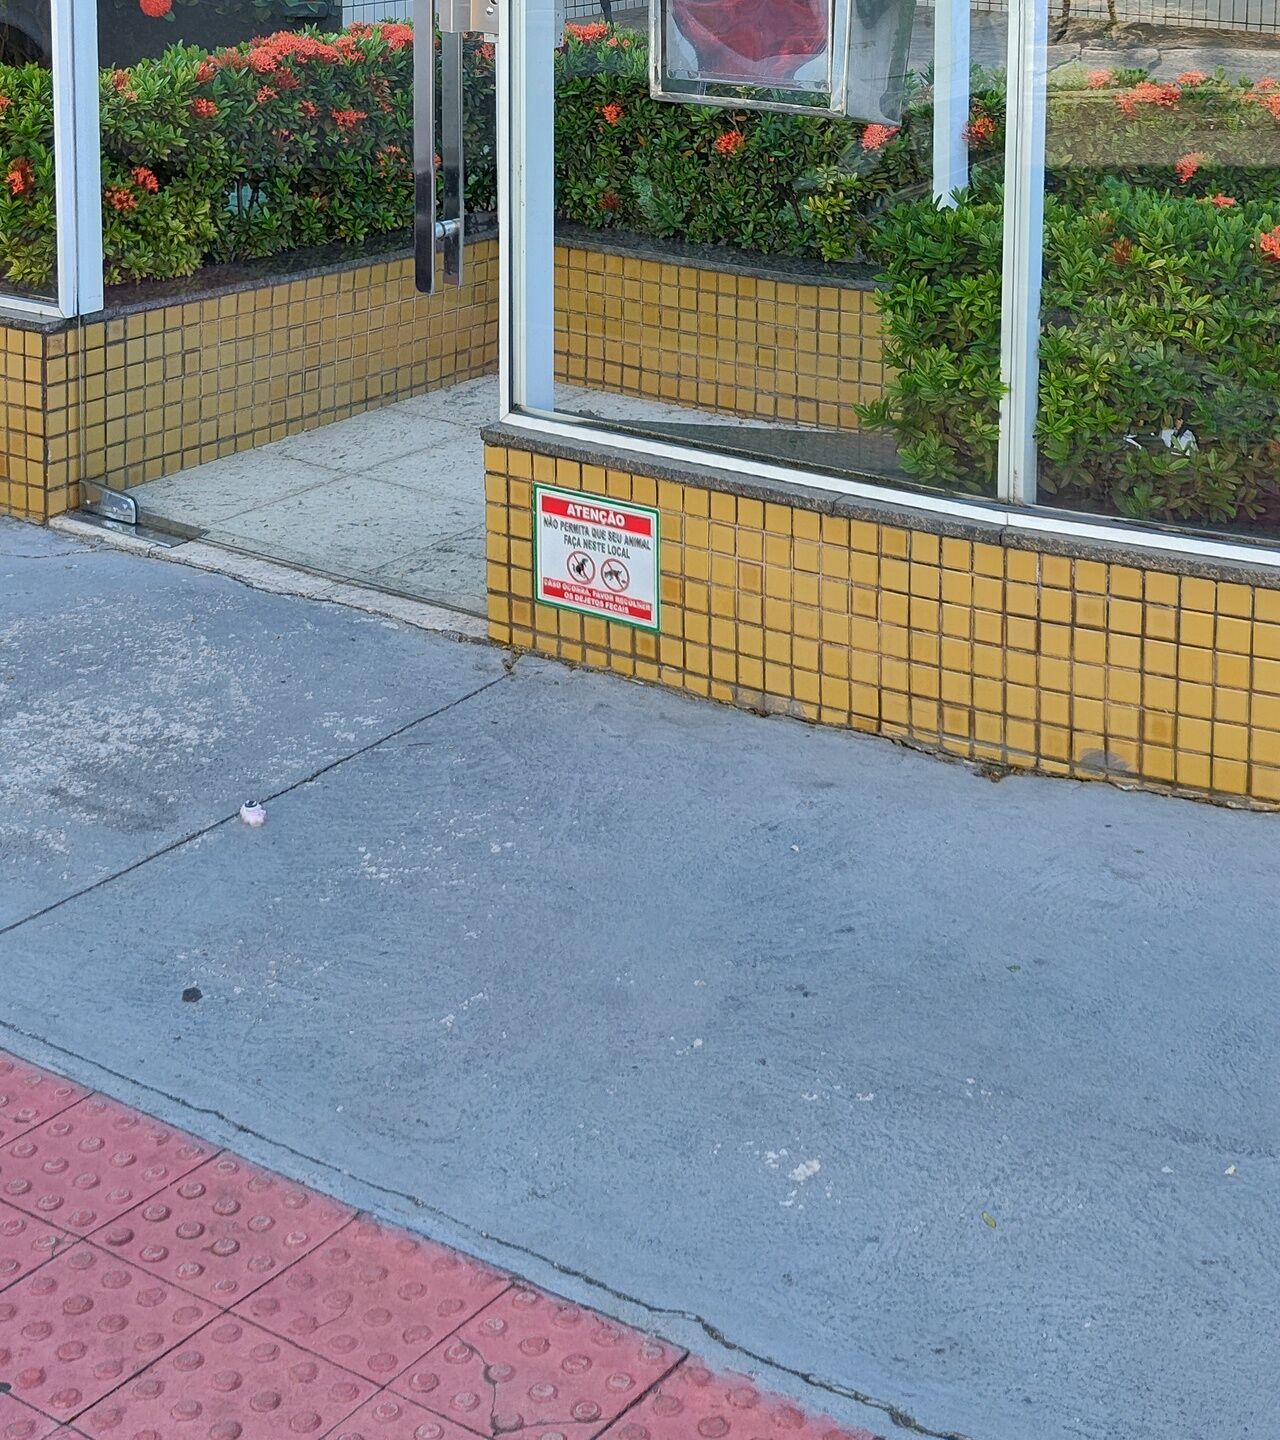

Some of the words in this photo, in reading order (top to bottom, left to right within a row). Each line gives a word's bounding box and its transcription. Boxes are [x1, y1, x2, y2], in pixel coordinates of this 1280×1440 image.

[566, 503, 626, 527] ATENÇÃO
[543, 515, 558, 528] NÃO
[560, 520, 590, 536] PERMITA
[591, 527, 607, 539] QUE
[607, 531, 622, 543] SEU
[624, 535, 651, 550] ANIMAL
[563, 534, 581, 549] FAÇA
[583, 538, 606, 553] NESTE
[607, 545, 631, 559] LOCAL
[543, 578, 561, 589] CASO
[562, 583, 592, 596] OCORRA,
[592, 590, 614, 601] FAVOR
[614, 595, 651, 610] RECOLHER
[564, 592, 573, 600] OS
[574, 594, 604, 608] DEJETOS
[604, 601, 630, 614] FECAIS
